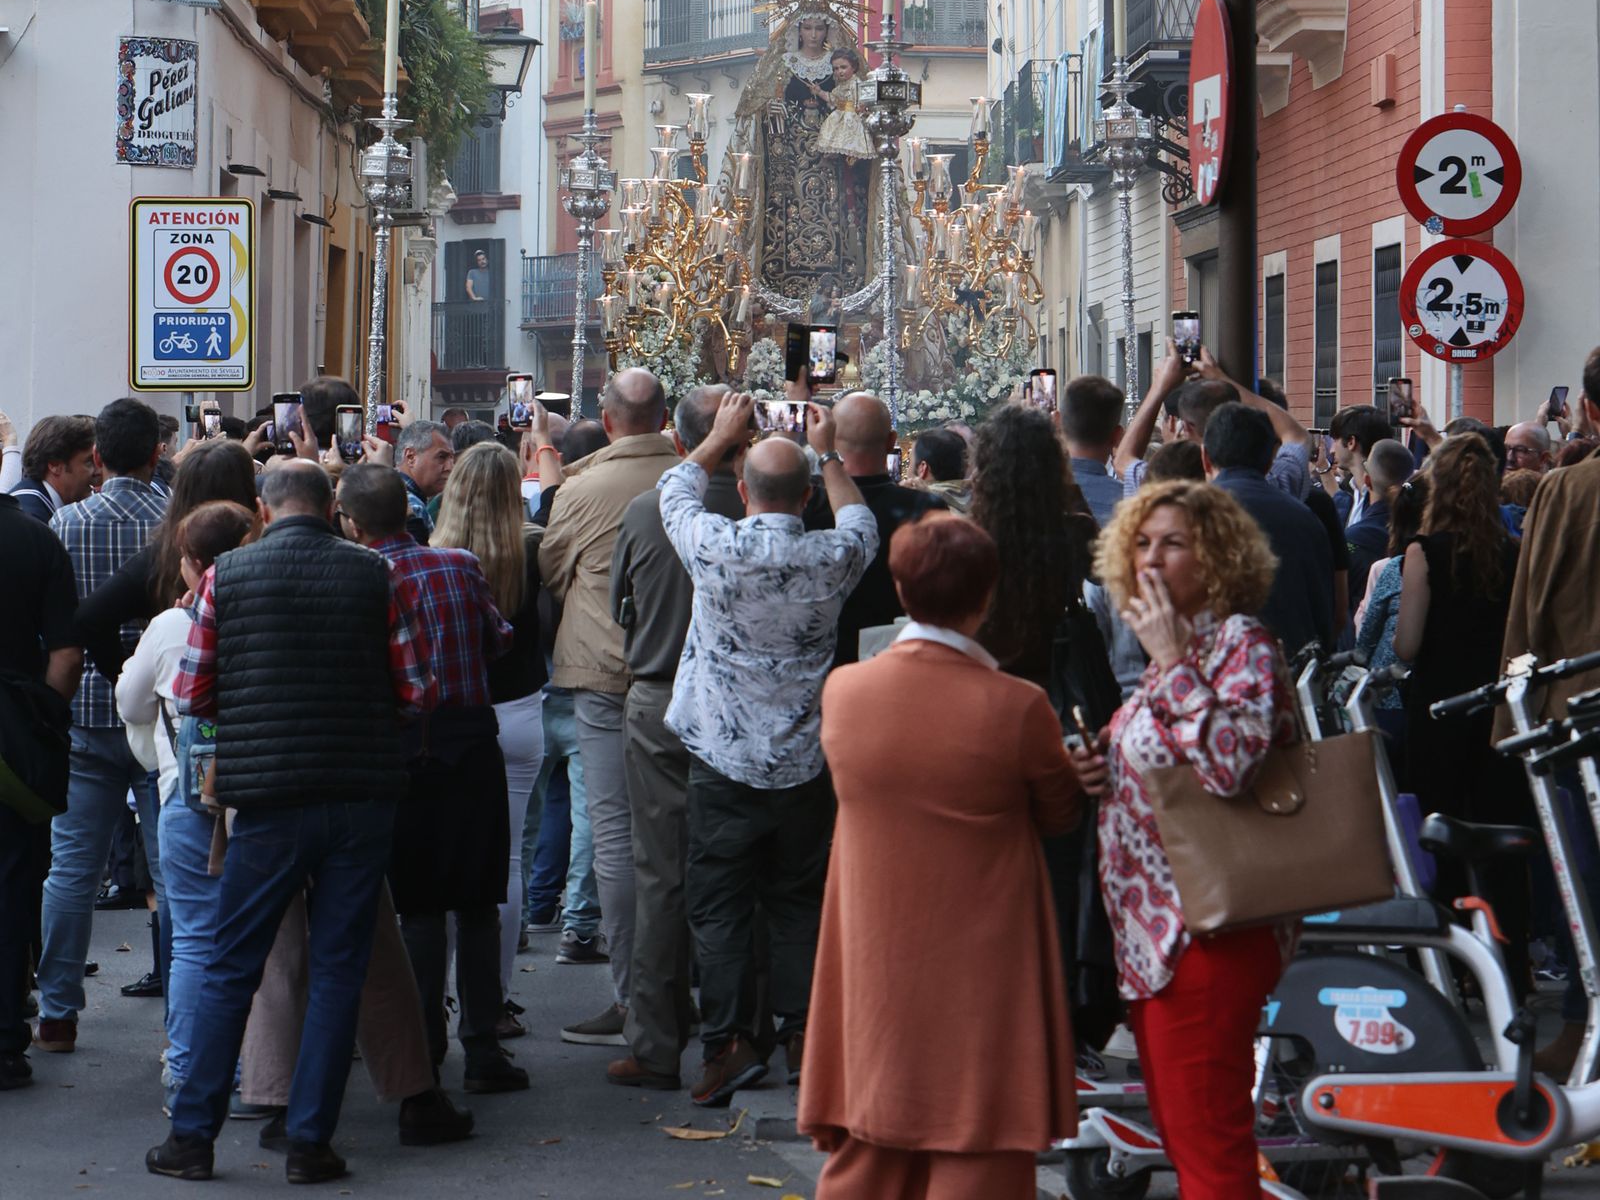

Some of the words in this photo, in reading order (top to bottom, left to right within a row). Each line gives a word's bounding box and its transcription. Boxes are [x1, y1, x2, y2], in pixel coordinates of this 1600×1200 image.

[149, 209, 240, 225] ATENCIÓN
[170, 233, 215, 244] ZONA
[177, 265, 208, 285] 20
[158, 316, 226, 326] PRIORIDAD
